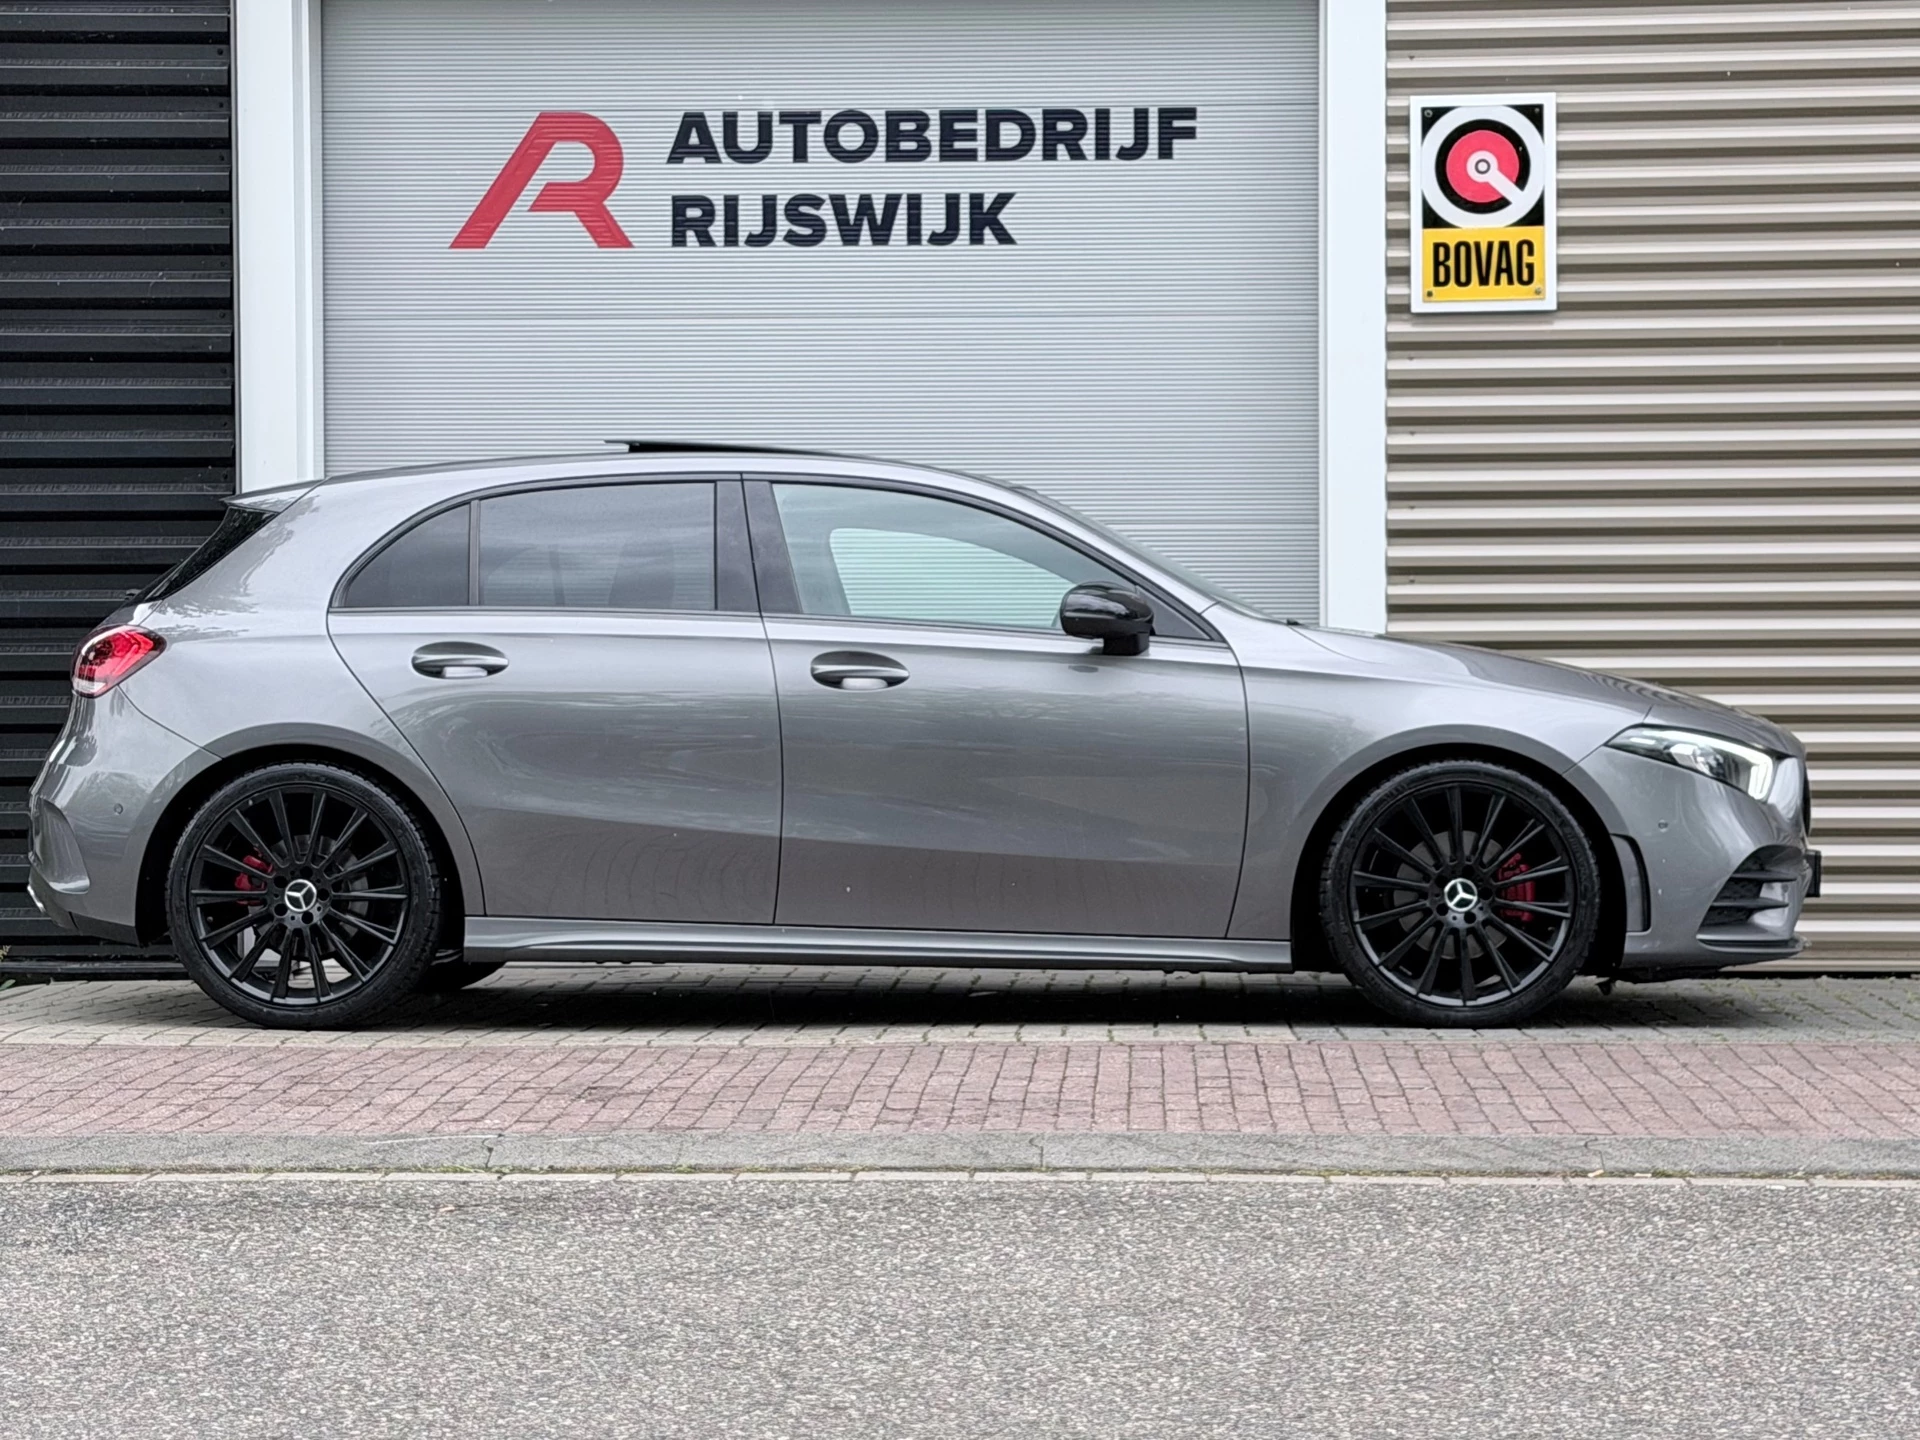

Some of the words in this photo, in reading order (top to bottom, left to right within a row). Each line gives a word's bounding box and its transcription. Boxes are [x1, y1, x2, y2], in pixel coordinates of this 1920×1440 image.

[667, 108, 1197, 164] AUTOBEDRIJF
[671, 192, 1018, 247] RIJSWIJK
[1432, 239, 1535, 287] BOVAG
